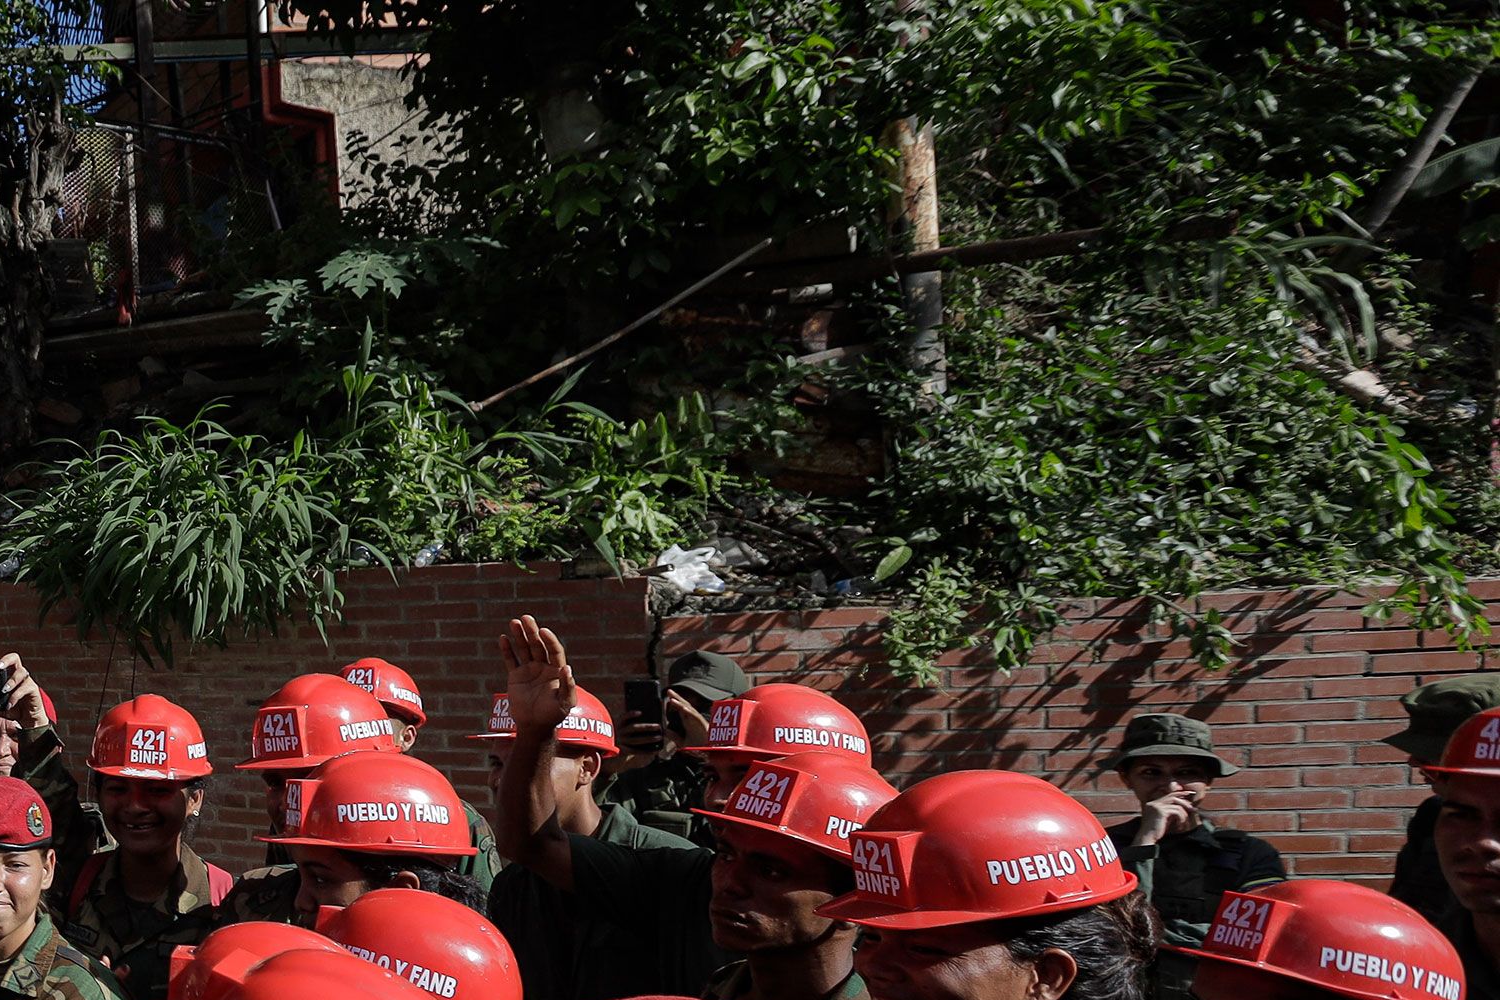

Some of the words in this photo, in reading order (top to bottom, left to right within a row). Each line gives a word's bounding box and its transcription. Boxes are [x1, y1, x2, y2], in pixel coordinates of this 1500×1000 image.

[347, 668, 374, 685] 421
[492, 699, 510, 716] 42
[712, 705, 740, 727] 421
[263, 712, 297, 737] 421
[339, 720, 380, 742] PUEBLO
[588, 718, 596, 732] Y
[709, 727, 739, 742] BINFP
[131, 729, 166, 751] 421
[264, 736, 300, 753] BINFP
[774, 727, 830, 747] PUEBLO
[830, 731, 841, 747] Y
[842, 733, 866, 754] FANB
[130, 749, 167, 765] BINFP
[286, 783, 301, 810] 421
[744, 769, 791, 802] 421
[337, 802, 399, 823] PUEBLO
[400, 803, 413, 822] Y
[415, 803, 450, 825] FANB
[735, 793, 782, 819] BINFP
[853, 838, 895, 875] 421
[986, 849, 1077, 885] PUEBLO
[1074, 846, 1092, 871] Y
[854, 870, 901, 897] BINFP
[1221, 897, 1271, 931] 421
[1213, 923, 1264, 950] BINFP
[394, 958, 409, 976] Y
[408, 964, 458, 998] FANB
[1319, 946, 1408, 985] PUEBLO
[1410, 965, 1425, 989] Y
